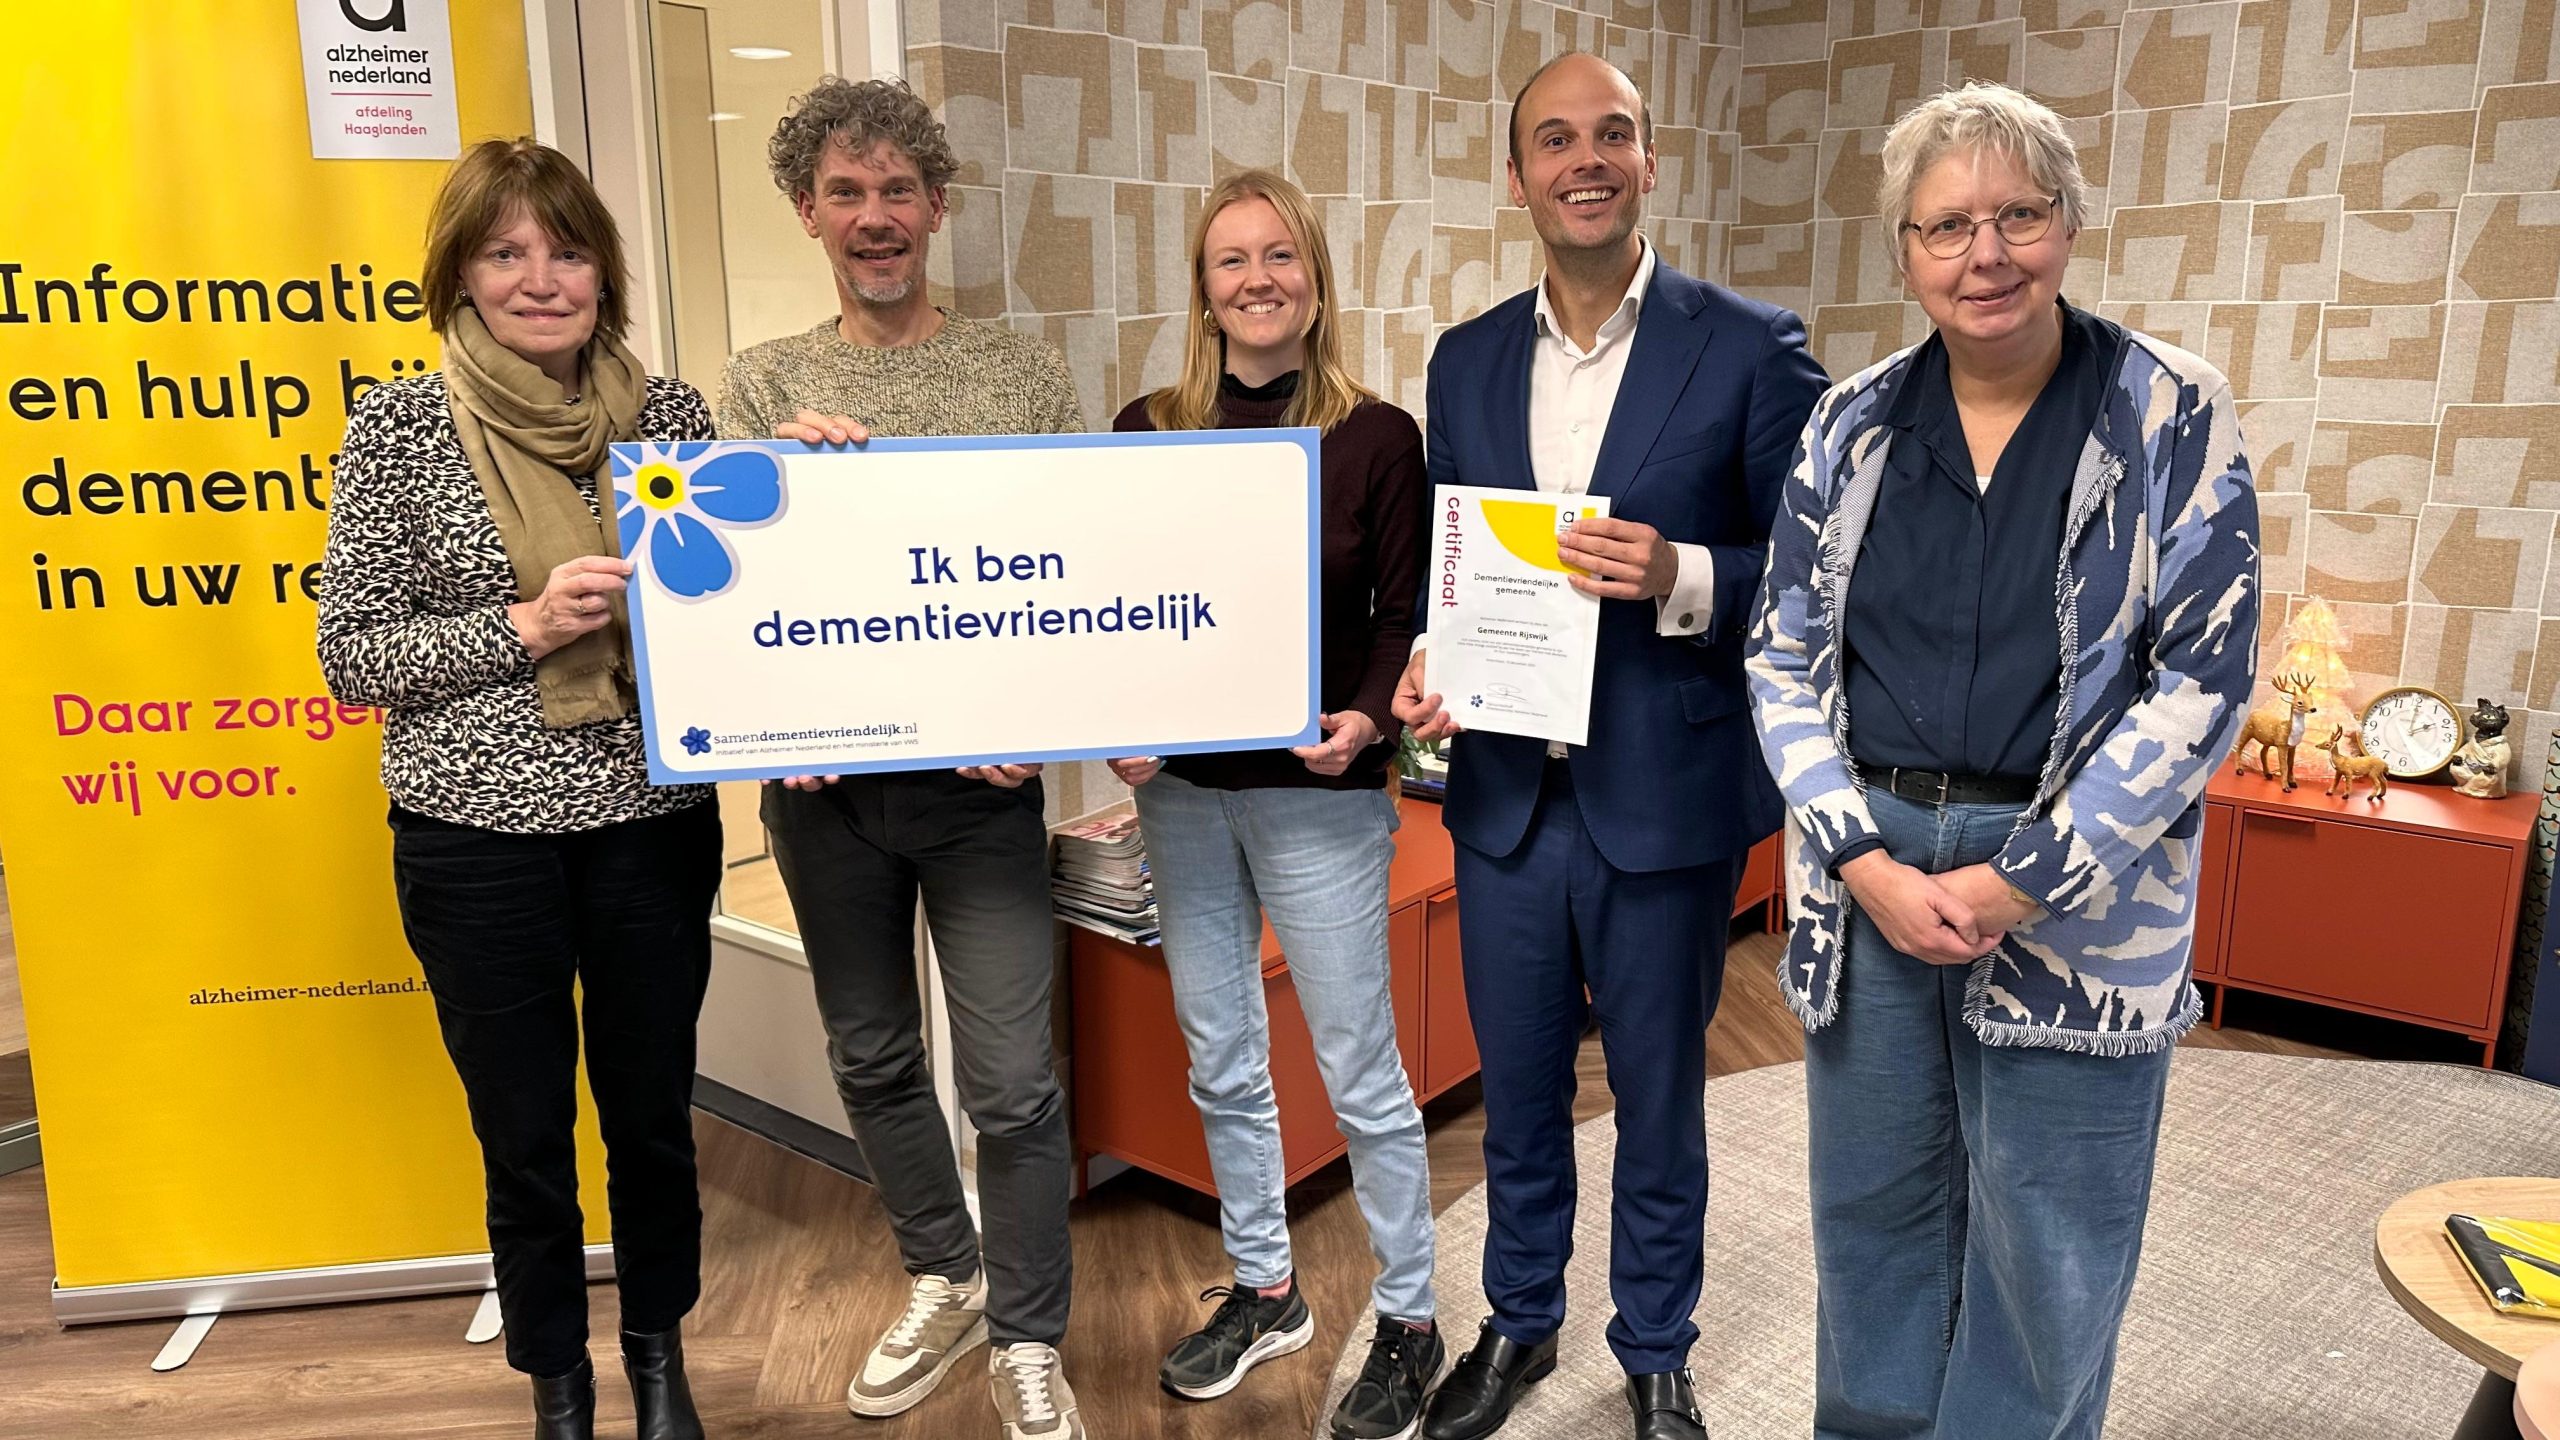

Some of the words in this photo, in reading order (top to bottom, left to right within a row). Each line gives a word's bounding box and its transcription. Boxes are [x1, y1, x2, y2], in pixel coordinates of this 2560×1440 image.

[326, 43, 429, 63] alzheimer
[329, 66, 432, 84] nederland
[355, 106, 413, 121] afdeling
[344, 123, 427, 138] Haaglanden
[0, 263, 422, 324] Informatie
[8, 375, 109, 421] en
[136, 359, 311, 439] hulp
[1441, 496, 1463, 608] certificaat
[908, 546, 959, 585] Ik
[975, 545, 1066, 583] ben
[32, 552, 106, 610] in
[134, 564, 241, 607] uw
[1474, 572, 1560, 590] Dementievriendelijke
[1495, 586, 1537, 598] gemeente
[752, 592, 1218, 648] dementievriendelijk
[1477, 626, 1518, 638] Gemeente
[1518, 630, 1549, 642] Rijswijk
[2379, 706, 2391, 717] 10
[2394, 698, 2404, 709] 11
[2433, 704, 2438, 714] 1
[53, 693, 193, 737] Daar
[2369, 720, 2378, 731] 9
[2441, 718, 2451, 729] 2
[713, 723, 918, 745] samendementievriendelijk.nl
[2370, 736, 2380, 747] 8
[2442, 732, 2452, 743] 3
[2382, 749, 2390, 760] 7
[2398, 756, 2408, 767] 6
[61, 760, 143, 817] wij
[156, 765, 298, 801] voor.
